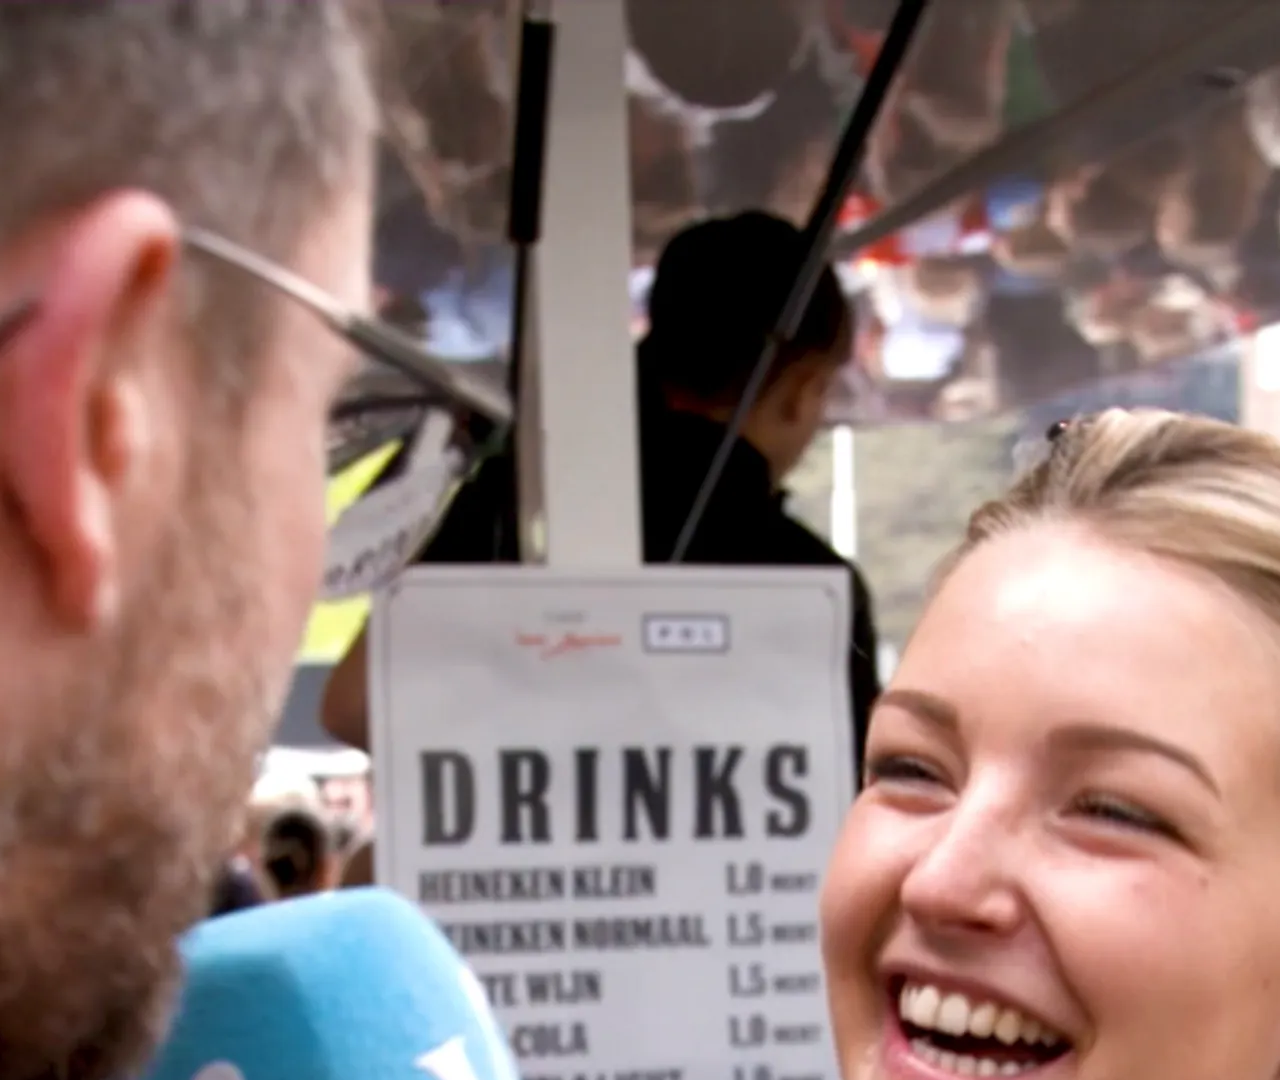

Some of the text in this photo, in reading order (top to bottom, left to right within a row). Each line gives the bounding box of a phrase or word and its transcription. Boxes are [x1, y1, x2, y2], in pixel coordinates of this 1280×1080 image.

[419, 744, 811, 847] DRINKS
[419, 868, 564, 902] HEINEKEN
[573, 865, 656, 898] KLEIN
[725, 862, 764, 895] 1.0
[438, 919, 564, 955] EINEKEN
[574, 915, 712, 949] NORMAAL
[726, 912, 764, 946] 1.5
[525, 970, 601, 1003] WIJN
[729, 963, 767, 997] 1.5
[729, 1014, 766, 1048] 1.0
